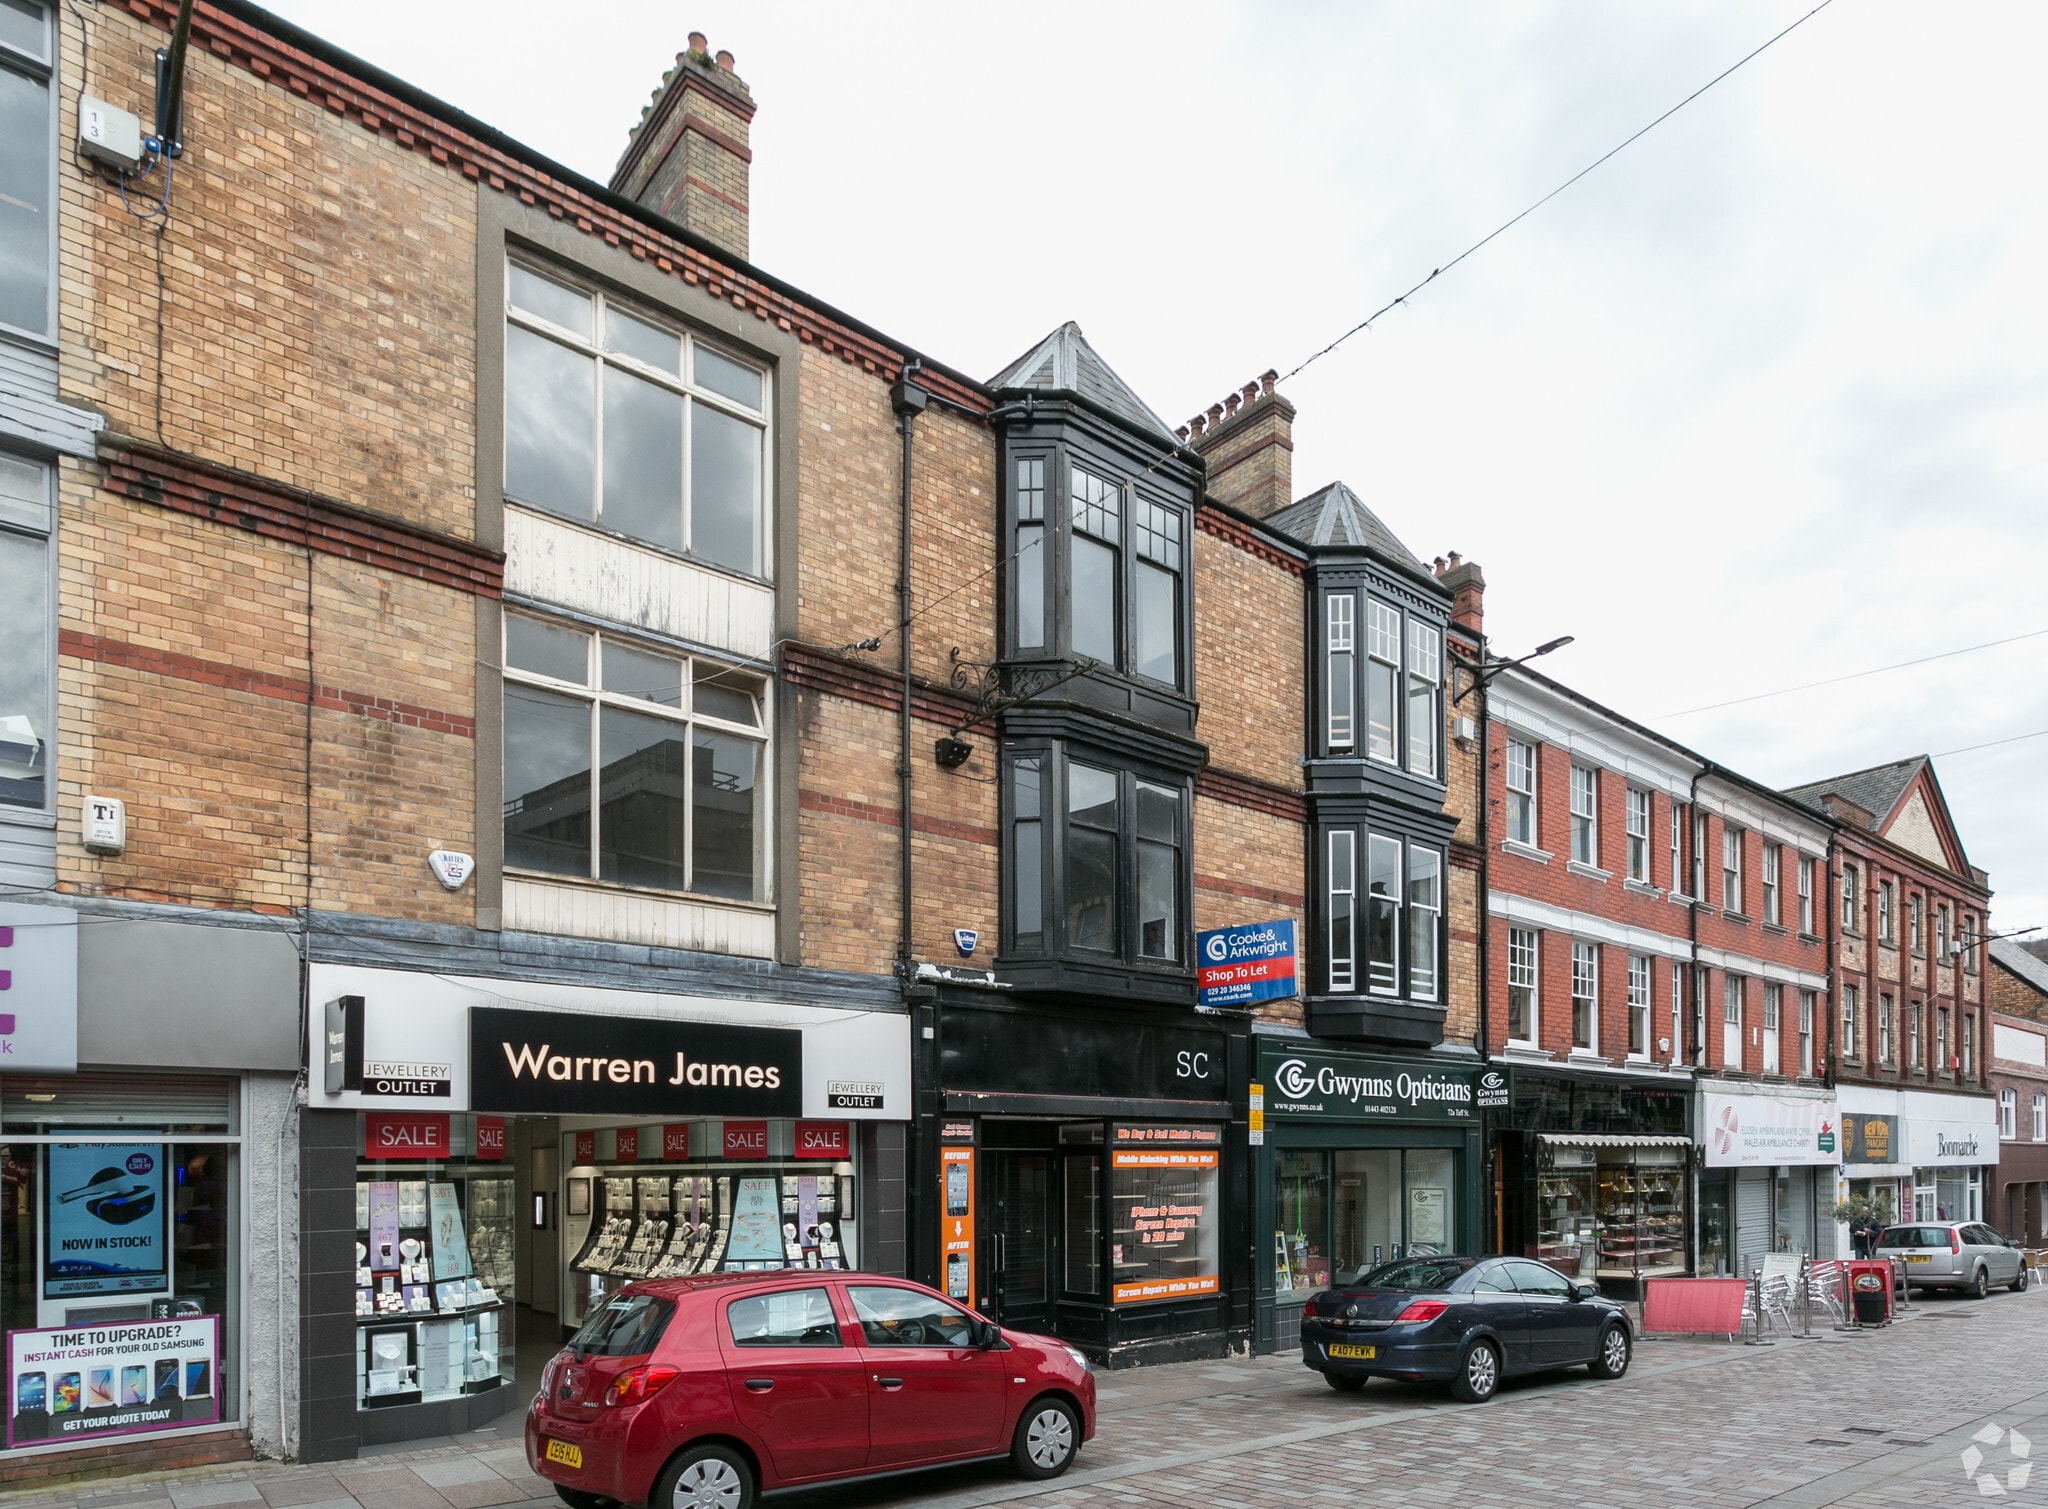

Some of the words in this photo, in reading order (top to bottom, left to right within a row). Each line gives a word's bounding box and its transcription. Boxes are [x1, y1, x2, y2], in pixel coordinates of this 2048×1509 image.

[91, 112, 97, 122] 1
[90, 126, 99, 137] 3
[1229, 945, 1288, 959] Arkwright
[1206, 970, 1234, 982] Shop
[1235, 967, 1248, 978] To
[1250, 964, 1268, 976] Let
[1207, 986, 1219, 996] 029
[1219, 985, 1228, 994] 20
[1229, 983, 1251, 993] 346346
[1207, 992, 1253, 1002] www.coark.com
[365, 1064, 448, 1077] JEWELLERY
[502, 1042, 655, 1083] Warren
[669, 1052, 780, 1088] James
[1176, 1051, 1209, 1079] SC
[376, 1080, 437, 1094] OUTLET
[830, 1083, 882, 1094] JEWELLERY
[1317, 1067, 1393, 1103] Gwynns
[1396, 1073, 1471, 1106] Opticians
[1477, 1089, 1508, 1098] Gwynns
[837, 1096, 876, 1107] OUTLET
[1274, 1103, 1324, 1112] www.gwynns.co.uk
[1364, 1105, 1379, 1113] 01443
[1117, 1129, 1130, 1139] We
[1131, 1129, 1145, 1140] Buy
[1146, 1129, 1153, 1139] &
[1154, 1129, 1168, 1139] Sell
[1169, 1130, 1191, 1139] Mobile
[1192, 1130, 1217, 1140] Phones
[1865, 1121, 1876, 1136] NEW
[1877, 1121, 1888, 1136] YORK
[381, 1126, 437, 1146] SALE
[479, 1129, 503, 1147] SALE
[667, 1134, 684, 1151] SALE
[727, 1133, 763, 1148] SALE
[804, 1131, 841, 1148] SALE
[1744, 1138, 1759, 1147] WALES
[1766, 1138, 1793, 1147] AMBULANCE
[1793, 1138, 1810, 1147] CHARITY
[578, 1138, 592, 1155] SALE
[619, 1136, 634, 1154] SALE
[1866, 1139, 1887, 1148] PANCAKE
[1936, 1132, 1978, 1157] Bonmarché
[944, 1152, 970, 1160] BEFORE
[1117, 1155, 1138, 1163] Mobile
[1139, 1155, 1168, 1164] Unlocking
[1170, 1155, 1186, 1163] While
[1188, 1155, 1199, 1163] You
[1200, 1155, 1213, 1163] Wait
[433, 1188, 452, 1198] SAVE
[743, 1182, 772, 1191] SALE
[1131, 1206, 1159, 1217] iPhone
[1160, 1205, 1168, 1216] &
[1168, 1205, 1203, 1216] Samsung
[1135, 1219, 1165, 1230] Screen
[1165, 1217, 1195, 1229] Repairs
[62, 1239, 93, 1250] NOW
[95, 1238, 107, 1249] IN
[110, 1236, 152, 1248] STOCK!
[1152, 1231, 1165, 1242] 20
[1166, 1231, 1185, 1241] mins
[947, 1241, 969, 1250] AFTER
[1117, 1288, 1141, 1298] Screen
[1142, 1285, 1168, 1295] Repairs
[1169, 1283, 1187, 1292] While
[1188, 1281, 1200, 1290] You
[1201, 1280, 1215, 1289] Wait
[51, 1333, 85, 1348] TIME
[88, 1331, 105, 1345] TO
[109, 1325, 182, 1343] UPGRADE?
[24, 1350, 66, 1363] INSTANT
[68, 1349, 94, 1359] CASH
[96, 1347, 115, 1356] FOR
[116, 1345, 139, 1354] YOUR
[142, 1342, 159, 1352] OLD
[160, 1338, 205, 1350] SAMSUNG
[1332, 1345, 1353, 1355] FA07
[1355, 1346, 1371, 1357] EWK
[63, 1420, 81, 1431] GET
[82, 1416, 108, 1428] YOUR
[109, 1413, 139, 1425] QUOTE
[140, 1409, 171, 1421] TODAY
[550, 1442, 565, 1459] CE15
[565, 1445, 580, 1464] HJJ
